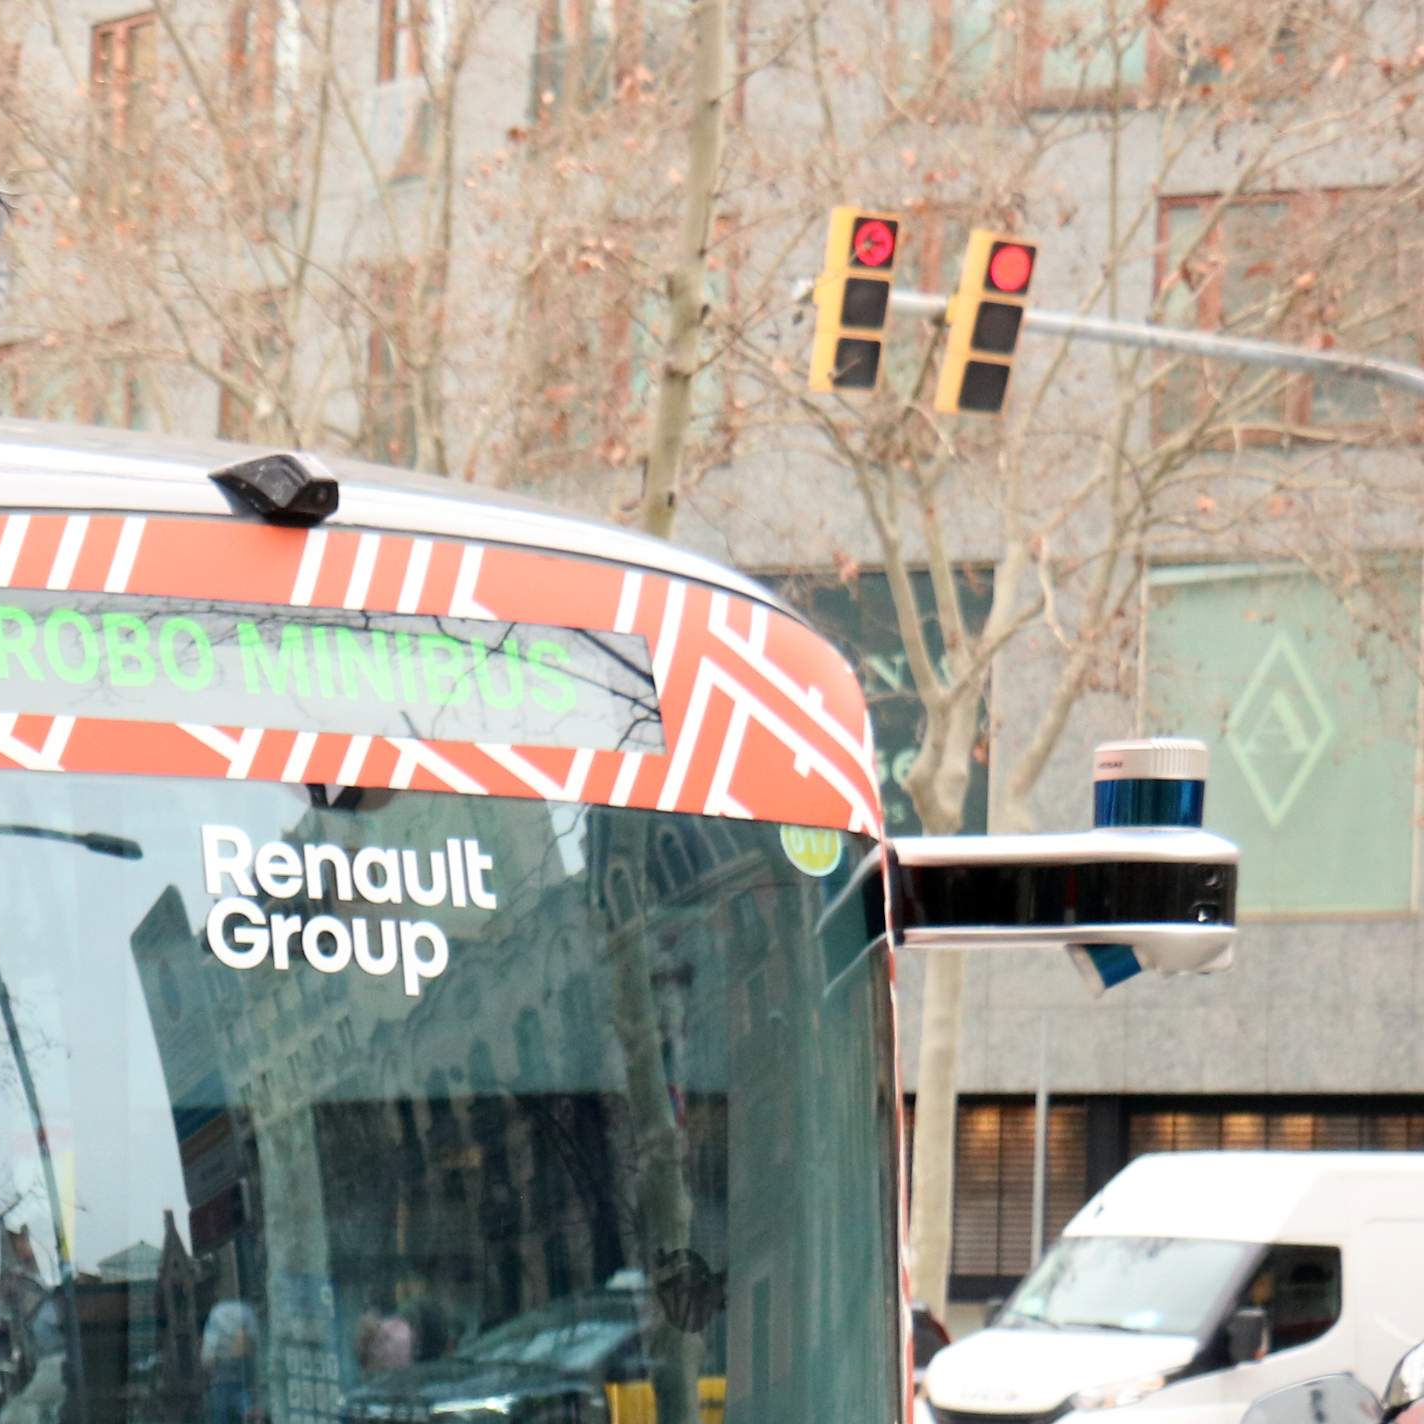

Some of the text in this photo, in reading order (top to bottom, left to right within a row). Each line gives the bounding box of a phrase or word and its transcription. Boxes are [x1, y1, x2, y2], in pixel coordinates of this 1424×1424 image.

[238, 621, 578, 715] MINIBUS
[200, 824, 497, 910] Renault
[205, 899, 448, 997] Group
